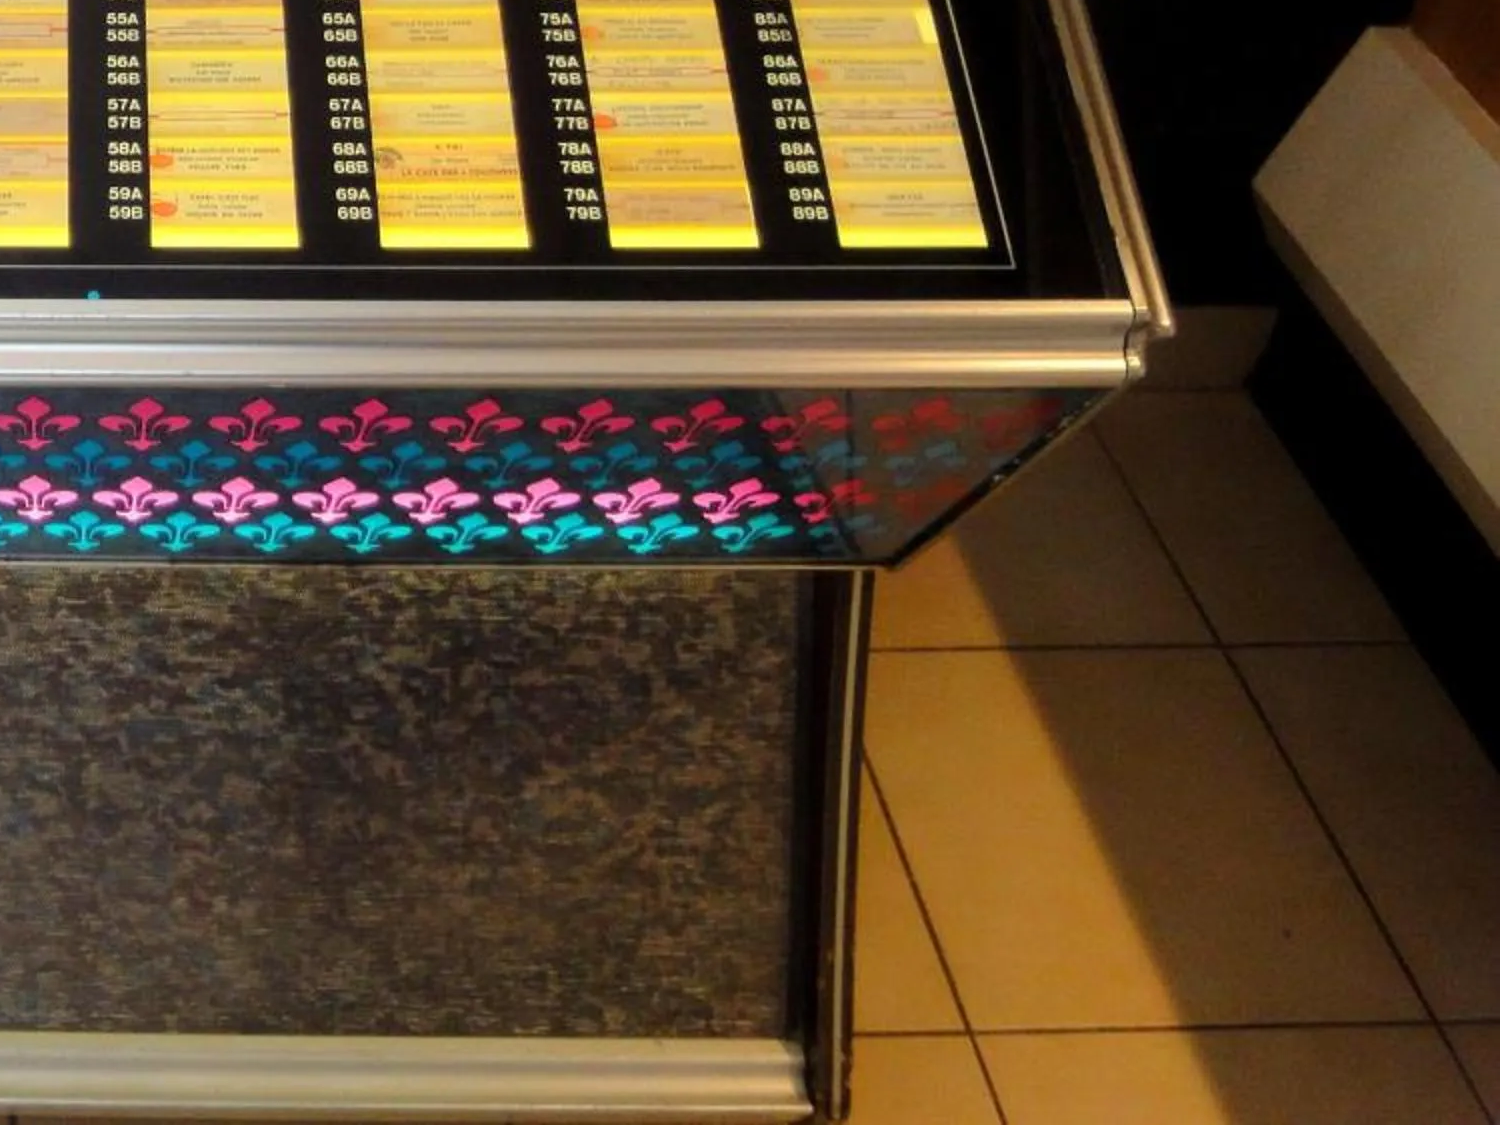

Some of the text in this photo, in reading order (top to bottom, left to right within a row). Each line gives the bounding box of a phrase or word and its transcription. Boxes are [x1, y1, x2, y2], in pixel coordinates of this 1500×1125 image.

[106, 13, 138, 25] 55A
[323, 13, 355, 25] 65A
[540, 13, 573, 25] 75A
[755, 13, 788, 25] 85A
[106, 29, 140, 41] 55B
[324, 29, 357, 41] 65B
[542, 29, 576, 41] 75B
[758, 29, 792, 42] 85B
[107, 55, 139, 67] 56A
[326, 56, 359, 68] 66A
[546, 55, 580, 68] 76A
[763, 55, 798, 68] 86A
[108, 72, 140, 85] 56B
[327, 73, 361, 85] 66B
[548, 73, 582, 85] 76B
[766, 72, 802, 85] 86B
[108, 99, 140, 111] 57A
[329, 99, 363, 111] 67A
[552, 99, 585, 111] 77A
[772, 99, 806, 111] 87A
[108, 116, 141, 129] 57B
[330, 117, 365, 129] 67B
[555, 117, 588, 130] 77B
[775, 117, 811, 129] 87B
[108, 142, 141, 155] 58A
[333, 143, 366, 155] 68A
[558, 142, 592, 155] 78A
[780, 142, 815, 155] 88A
[108, 160, 142, 173] 58B
[334, 161, 368, 174] 68B
[560, 160, 594, 174] 78B
[784, 160, 819, 174] 88B
[109, 187, 142, 200] 59A
[336, 188, 370, 201] 69A
[564, 188, 598, 201] 79A
[789, 188, 824, 201] 89A
[110, 206, 143, 219] 59B
[338, 207, 372, 220] 69B
[567, 207, 602, 219] 79B
[793, 206, 829, 220] 89B
